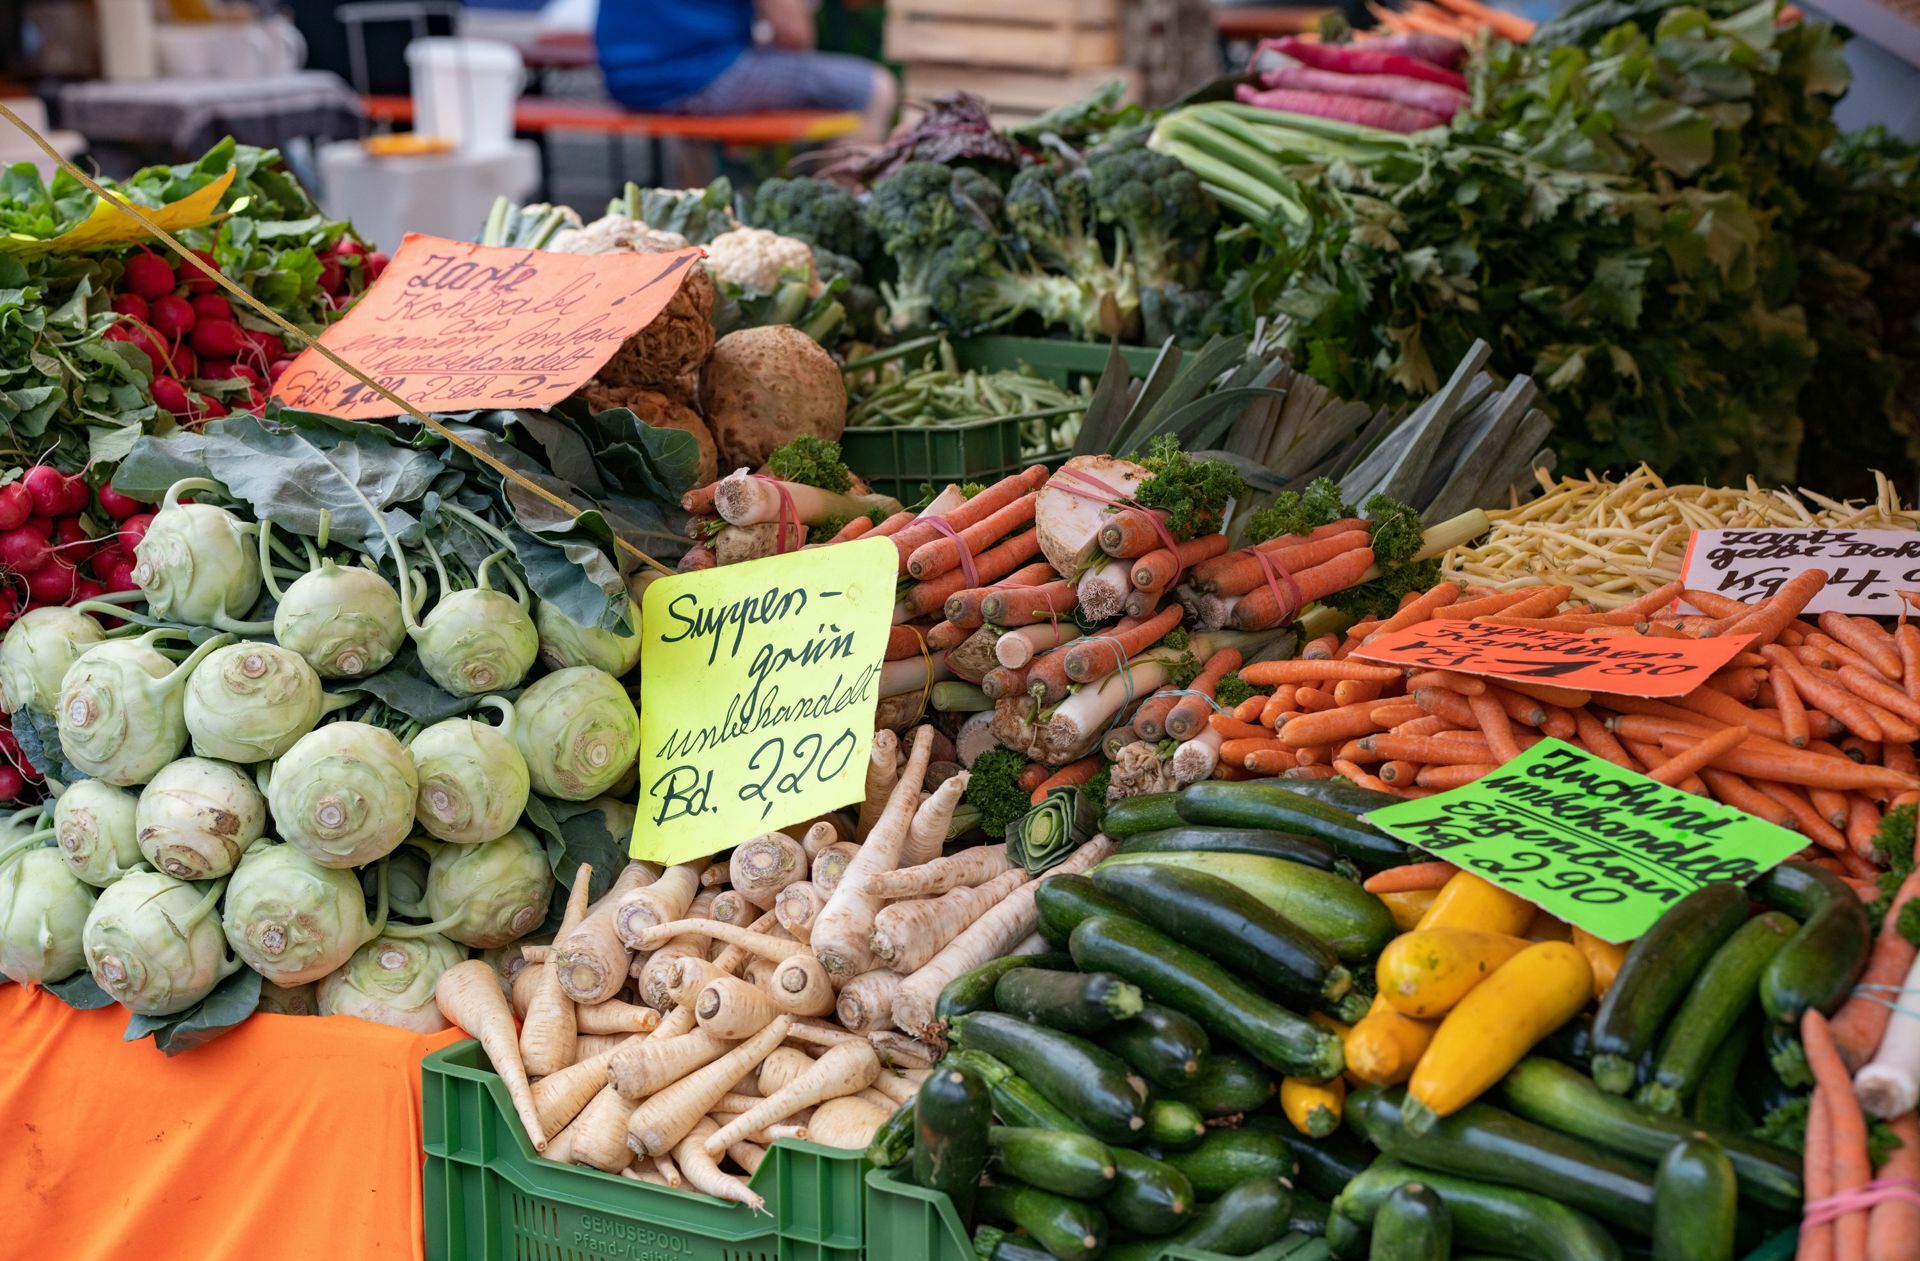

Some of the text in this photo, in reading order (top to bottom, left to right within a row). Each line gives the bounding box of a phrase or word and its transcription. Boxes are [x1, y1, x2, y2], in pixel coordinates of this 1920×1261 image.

[439, 318, 511, 336] aus
[366, 347, 595, 371] unbehandelt
[1706, 544, 1826, 570] gelbe
[739, 623, 856, 724] grün
[656, 658, 883, 760] unbehandelt
[649, 727, 857, 827] Bd. 2,20
